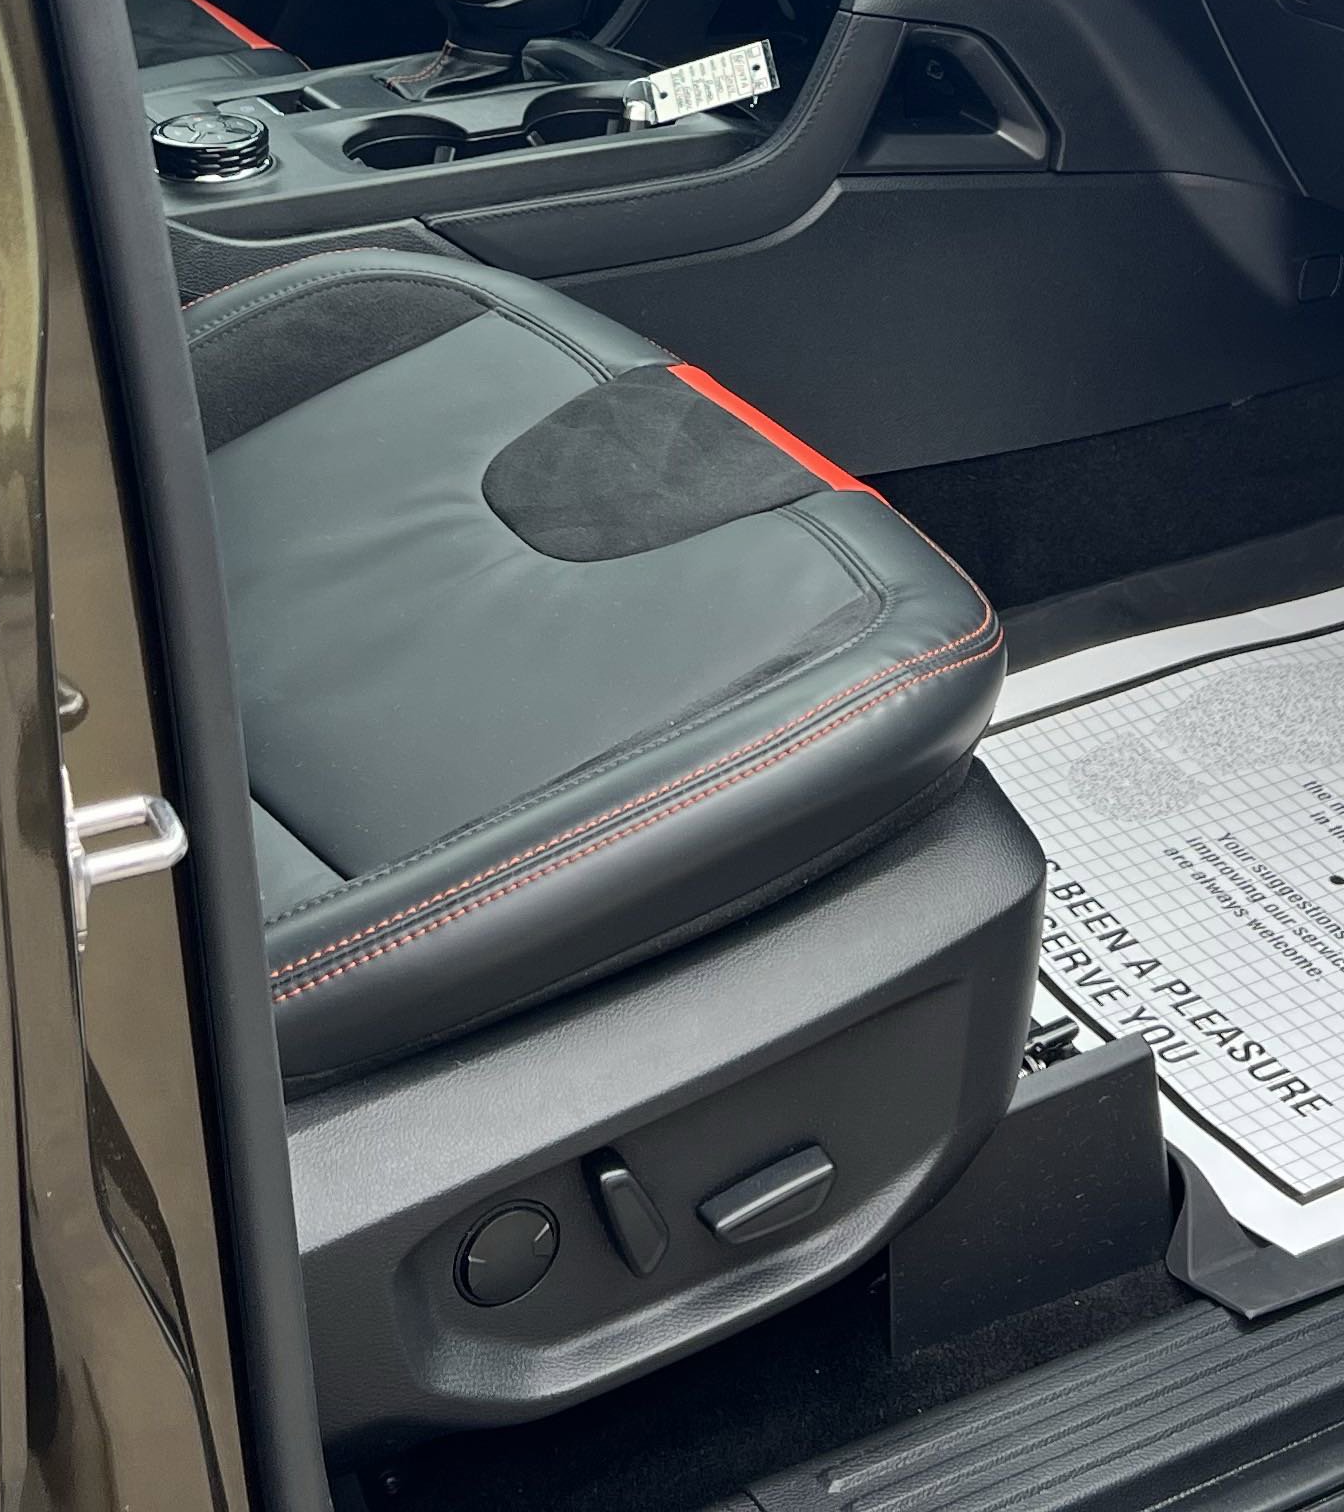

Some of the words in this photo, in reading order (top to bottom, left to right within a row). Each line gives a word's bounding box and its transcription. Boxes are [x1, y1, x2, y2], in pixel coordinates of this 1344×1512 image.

[1303, 780, 1332, 801] the
[1310, 810, 1331, 826] in
[1217, 832, 1256, 863] Your
[1186, 836, 1266, 904] improving
[1264, 903, 1297, 927] our
[1163, 847, 1194, 870] are
[1191, 871, 1249, 918] always
[1247, 918, 1324, 983] welcome.
[1048, 880, 1141, 953] BEEN
[1122, 956, 1162, 979] A
[1151, 978, 1333, 1118] PLEASURE
[1118, 1006, 1200, 1064] YOU
